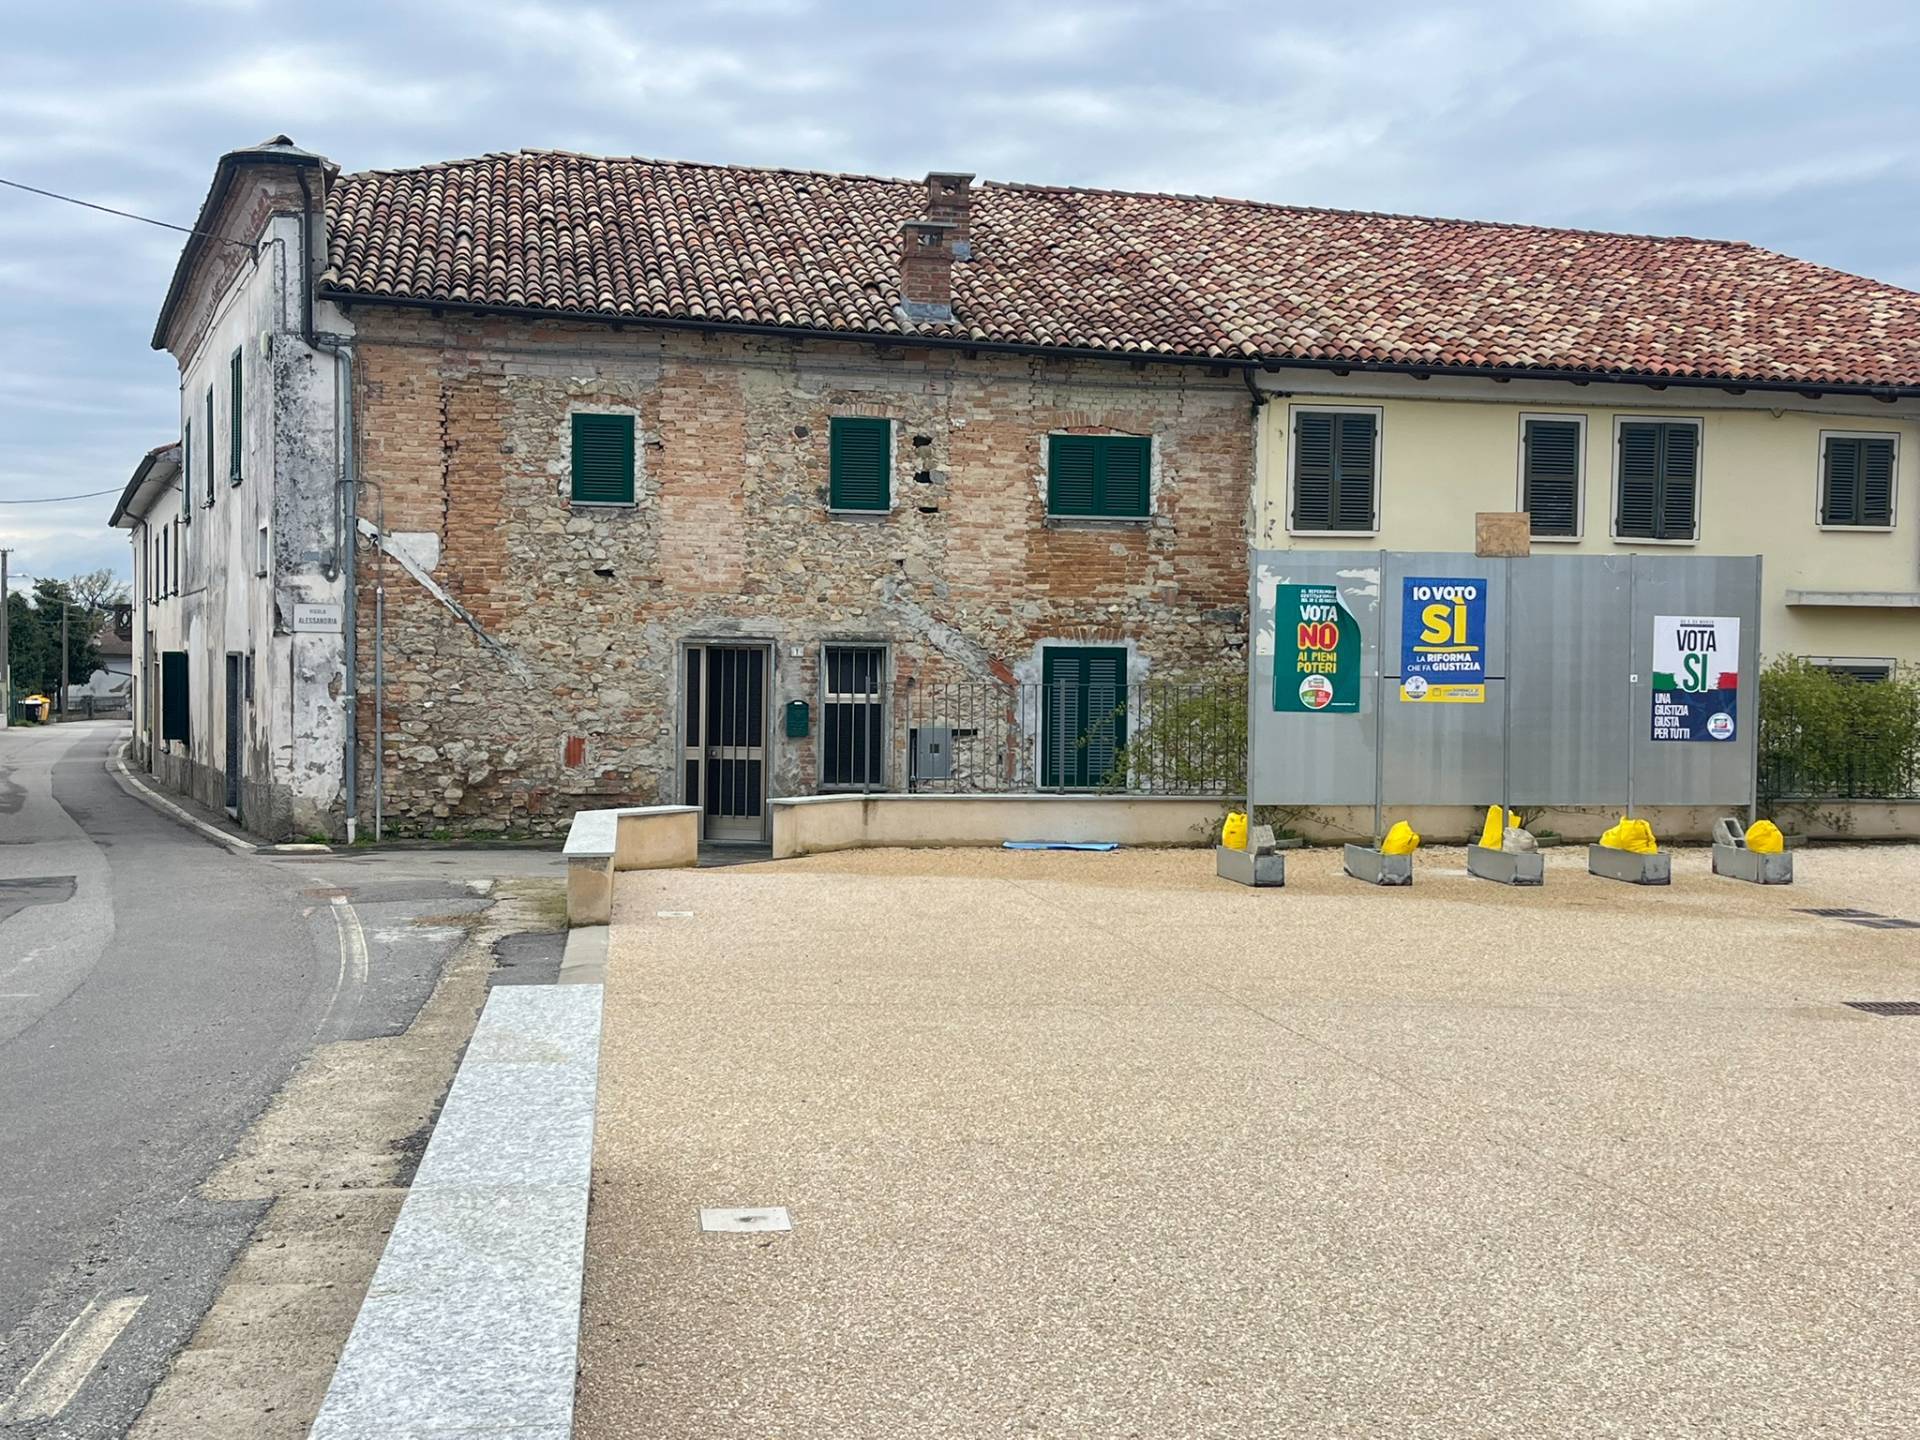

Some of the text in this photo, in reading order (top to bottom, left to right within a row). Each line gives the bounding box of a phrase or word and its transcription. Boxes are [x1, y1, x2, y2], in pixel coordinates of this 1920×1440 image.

[1413, 586, 1477, 600] IO VOTO
[1299, 604, 1338, 622] VOTA
[1420, 596, 1467, 644] SÌ
[1298, 622, 1338, 651] NO
[1677, 629, 1717, 652] VOTA
[1298, 652, 1337, 662] AI PIENI
[1427, 653, 1472, 662] RIFORMA
[1297, 662, 1337, 673] POTERI
[1432, 662, 1480, 671] GIUSTIZIA
[1682, 653, 1708, 691] SI
[1655, 693, 1671, 704] UNA
[1654, 705, 1689, 716] GIUSTIZIA
[1654, 716, 1680, 727] GIUSTA
[1654, 728, 1690, 739] PER TUTTI
